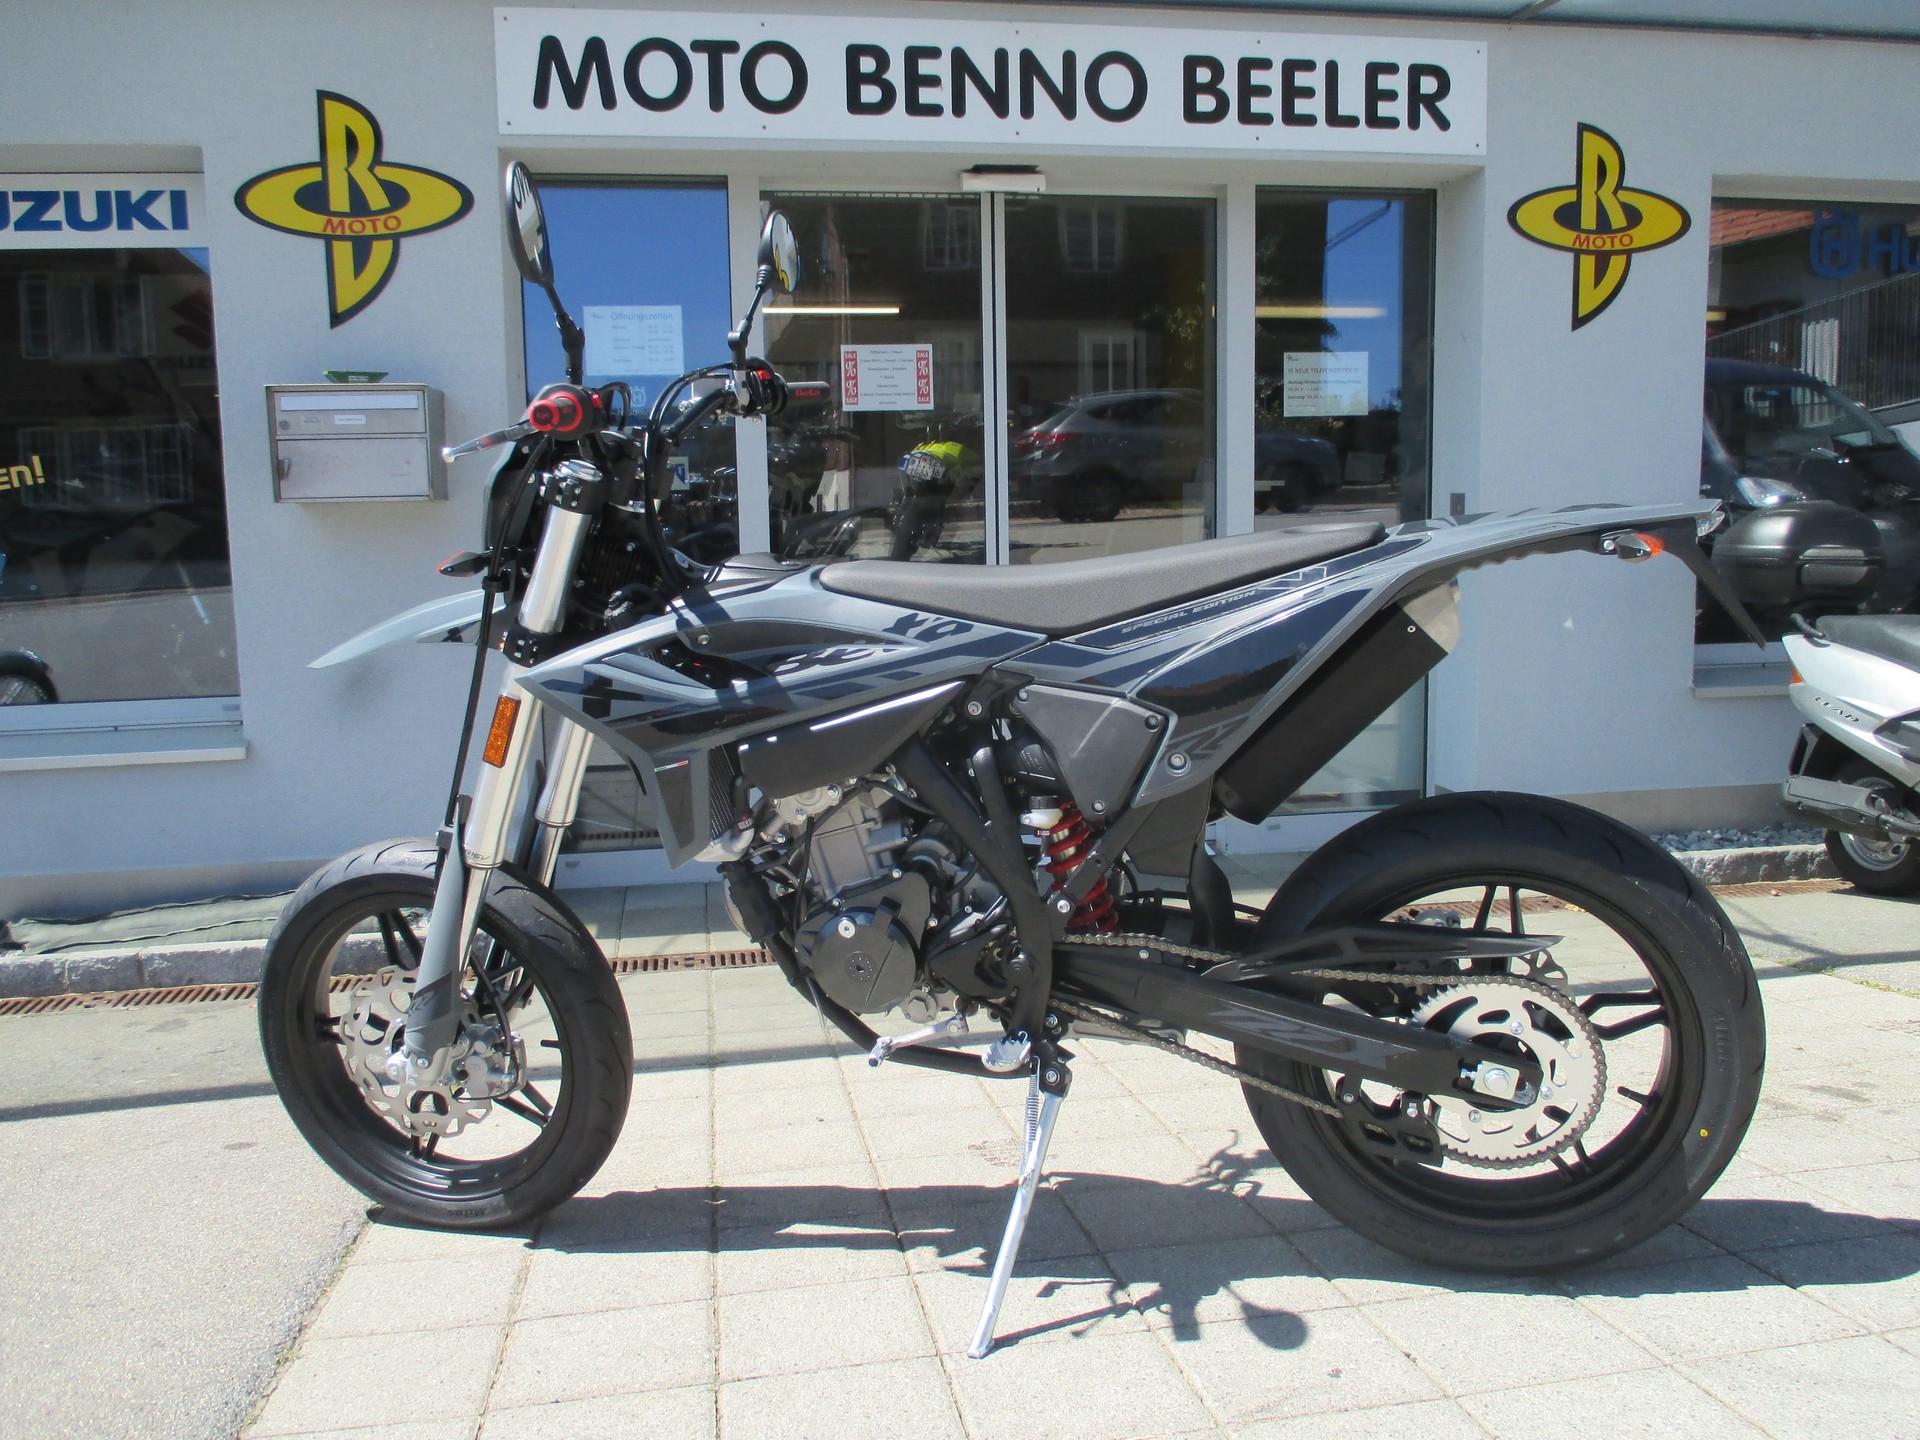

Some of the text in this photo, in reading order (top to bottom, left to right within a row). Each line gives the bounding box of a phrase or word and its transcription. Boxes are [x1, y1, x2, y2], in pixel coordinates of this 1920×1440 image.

[533, 35, 1451, 131] MOTO BENNO BEELER
[0, 190, 189, 232] ZUKI
[322, 214, 402, 235] MOTO
[1571, 233, 1634, 249] MOTO
[610, 311, 673, 322] Öffnungszeiten
[1121, 589, 1257, 634] SPECIAL EDITION
[1814, 696, 1860, 722] LEAD
